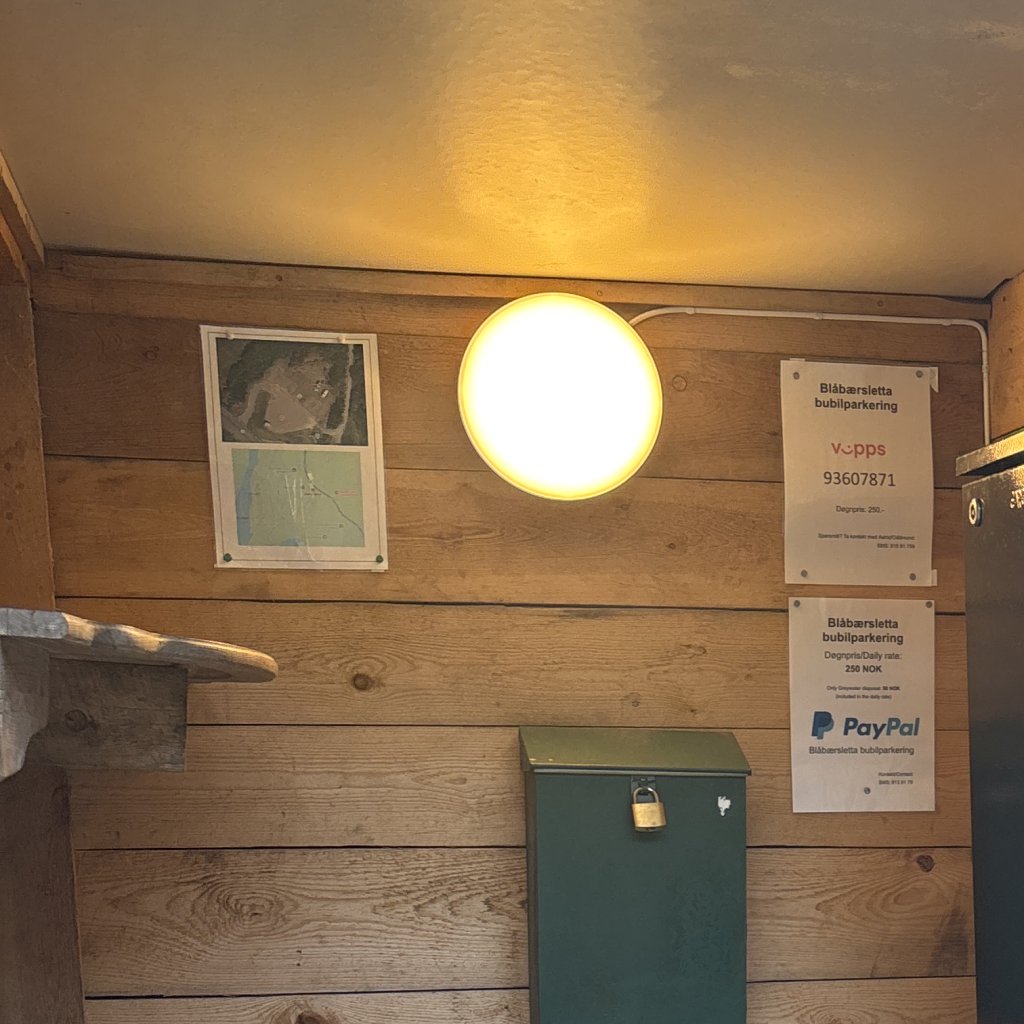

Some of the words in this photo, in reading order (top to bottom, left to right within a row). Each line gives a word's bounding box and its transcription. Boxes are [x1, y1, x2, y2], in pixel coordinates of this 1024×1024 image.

[819, 382, 893, 397] Blåbærsletta
[814, 397, 899, 413] bubilparkering
[823, 471, 896, 487] 93607871
[827, 617, 899, 630] Blåbærsletta
[822, 631, 904, 646] bubilparkering
[824, 650, 883, 661] Døgnpris/Daily
[884, 652, 902, 660] rate:
[845, 664, 861, 673] 250
[862, 664, 882, 673] NOK
[843, 717, 920, 740] PayPal
[809, 746, 858, 755] Blåbærsletta
[859, 746, 915, 756] bubilparkering
